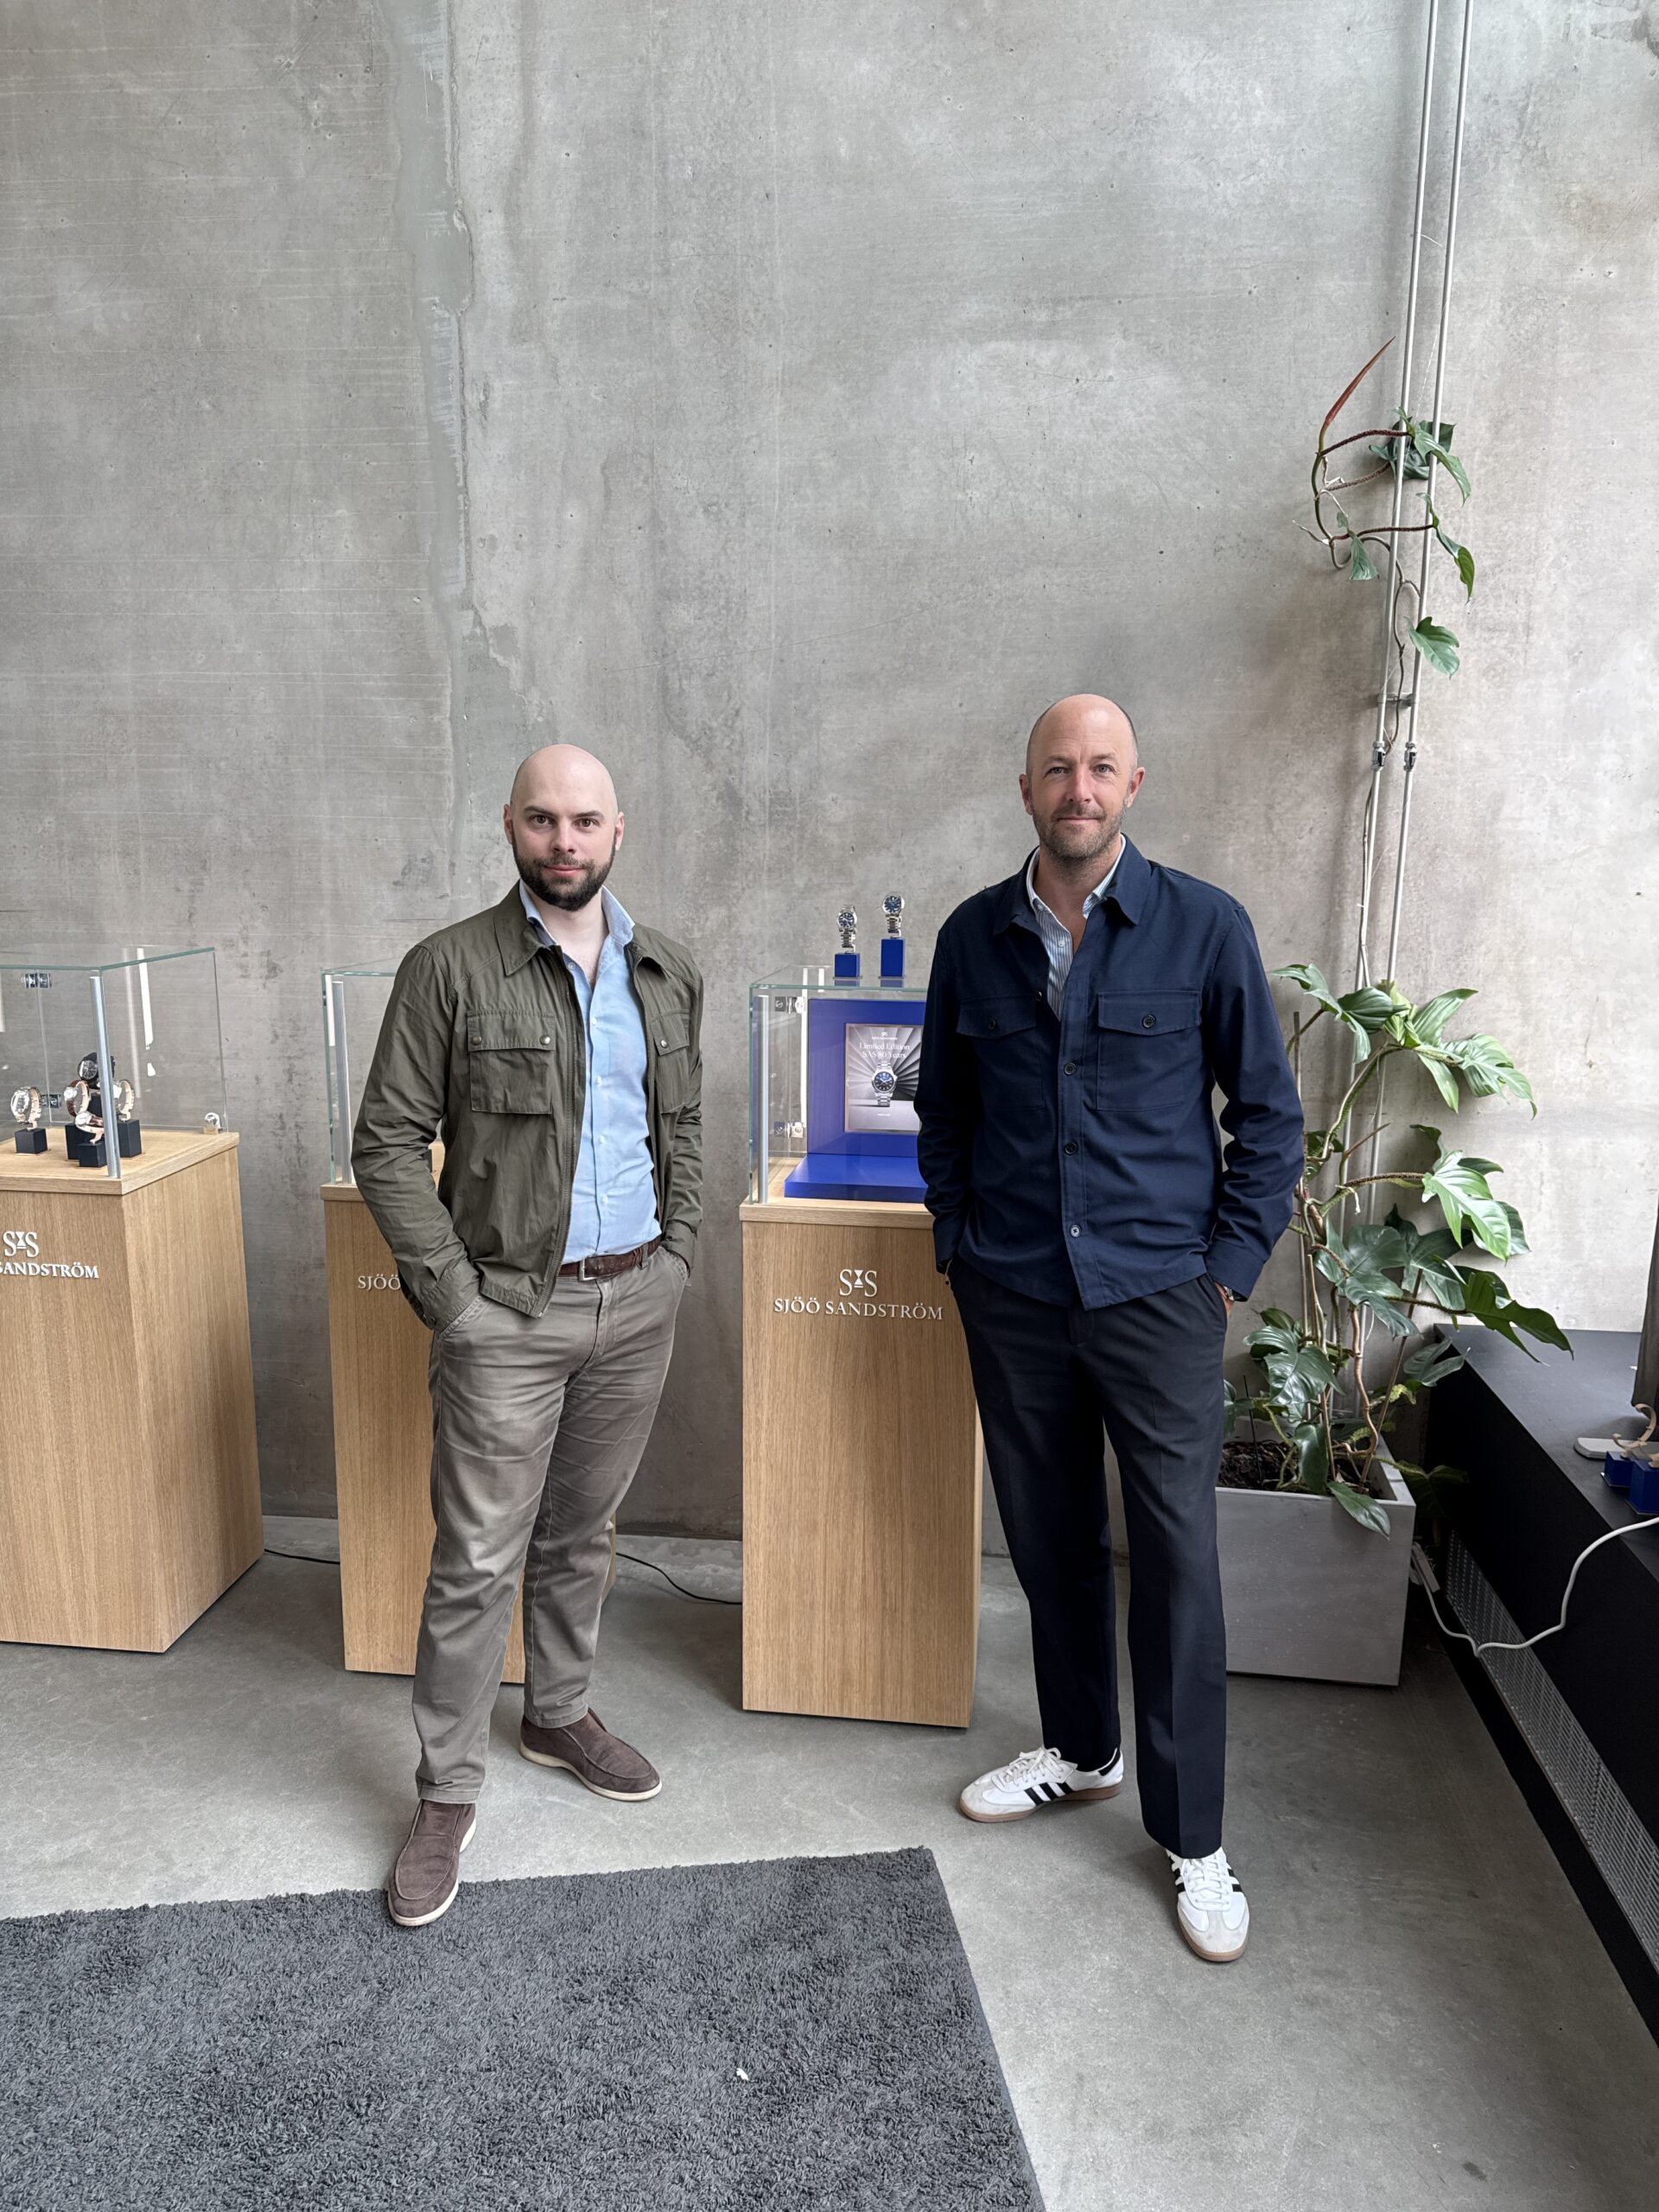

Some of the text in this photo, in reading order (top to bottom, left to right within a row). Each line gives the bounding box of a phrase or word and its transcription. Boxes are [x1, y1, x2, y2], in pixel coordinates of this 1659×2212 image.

[358, 1273, 401, 1292] SJÖÖ
[773, 1296, 944, 1320] SJÖÖ SANDSTRÖM
